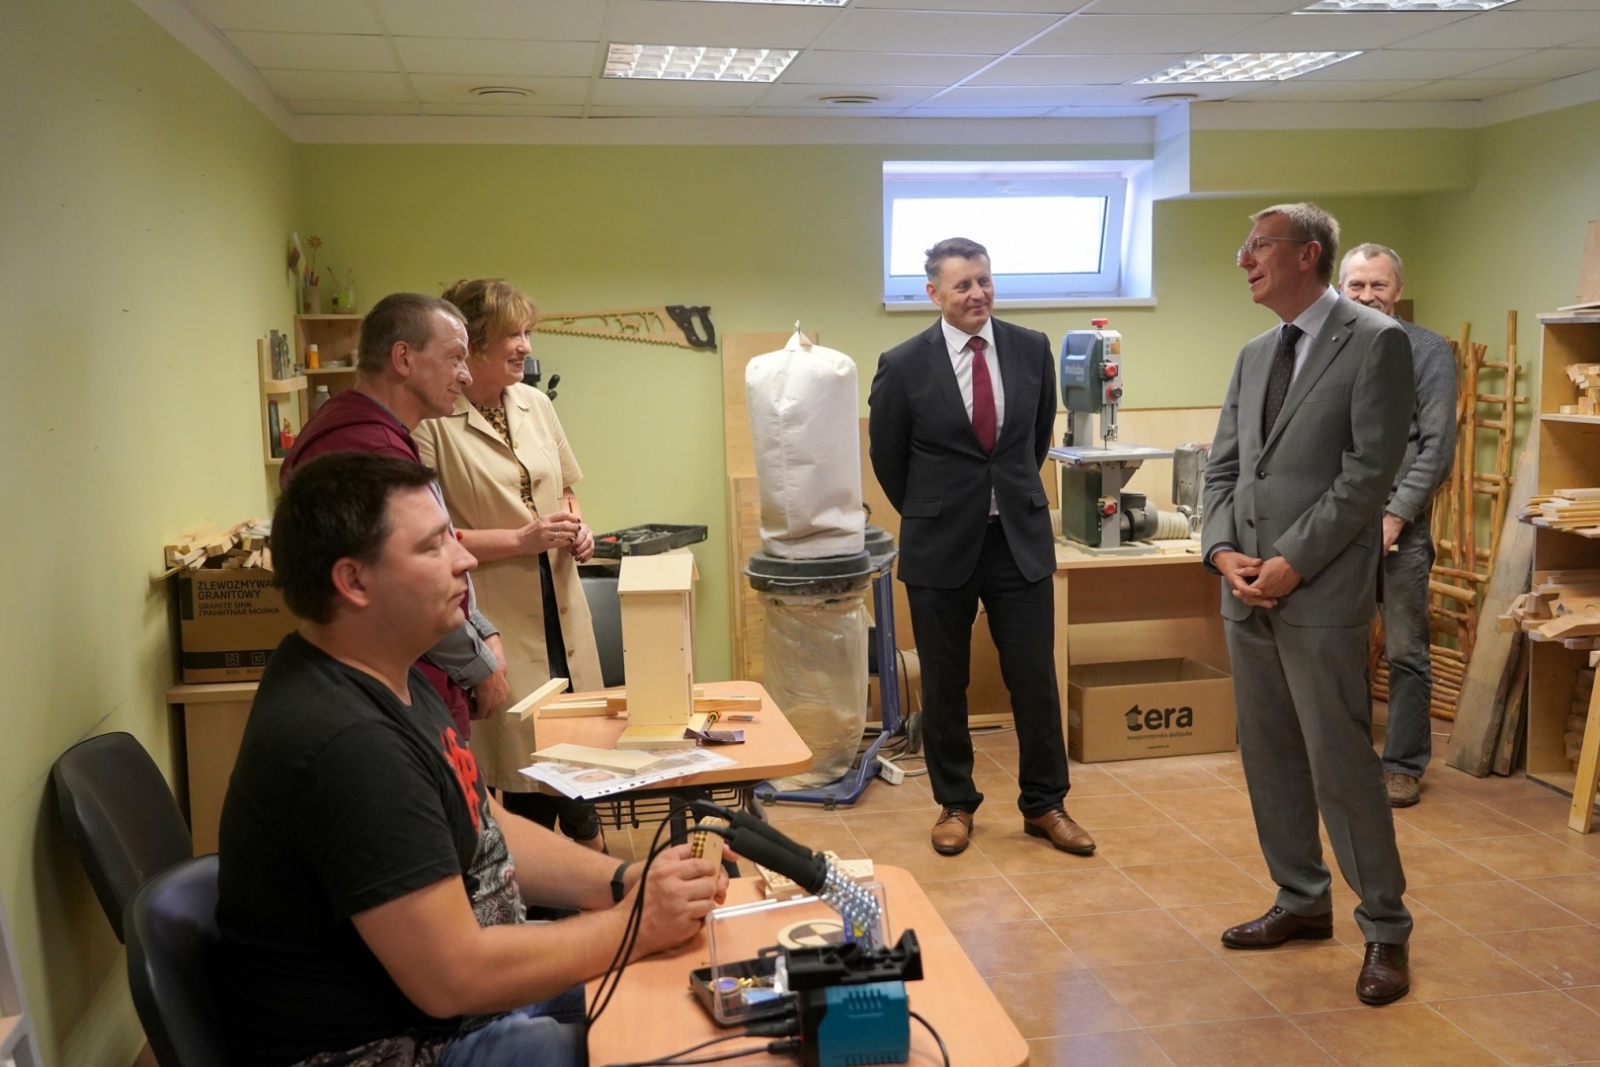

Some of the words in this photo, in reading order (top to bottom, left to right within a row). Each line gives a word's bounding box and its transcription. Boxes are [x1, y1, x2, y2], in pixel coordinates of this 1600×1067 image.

[197, 580, 273, 590] ZLEWOZMYWA
[198, 589, 261, 600] GRANITOWY
[198, 609, 248, 617] ГРАНИТНАЯ
[1124, 704, 1192, 731] tera
